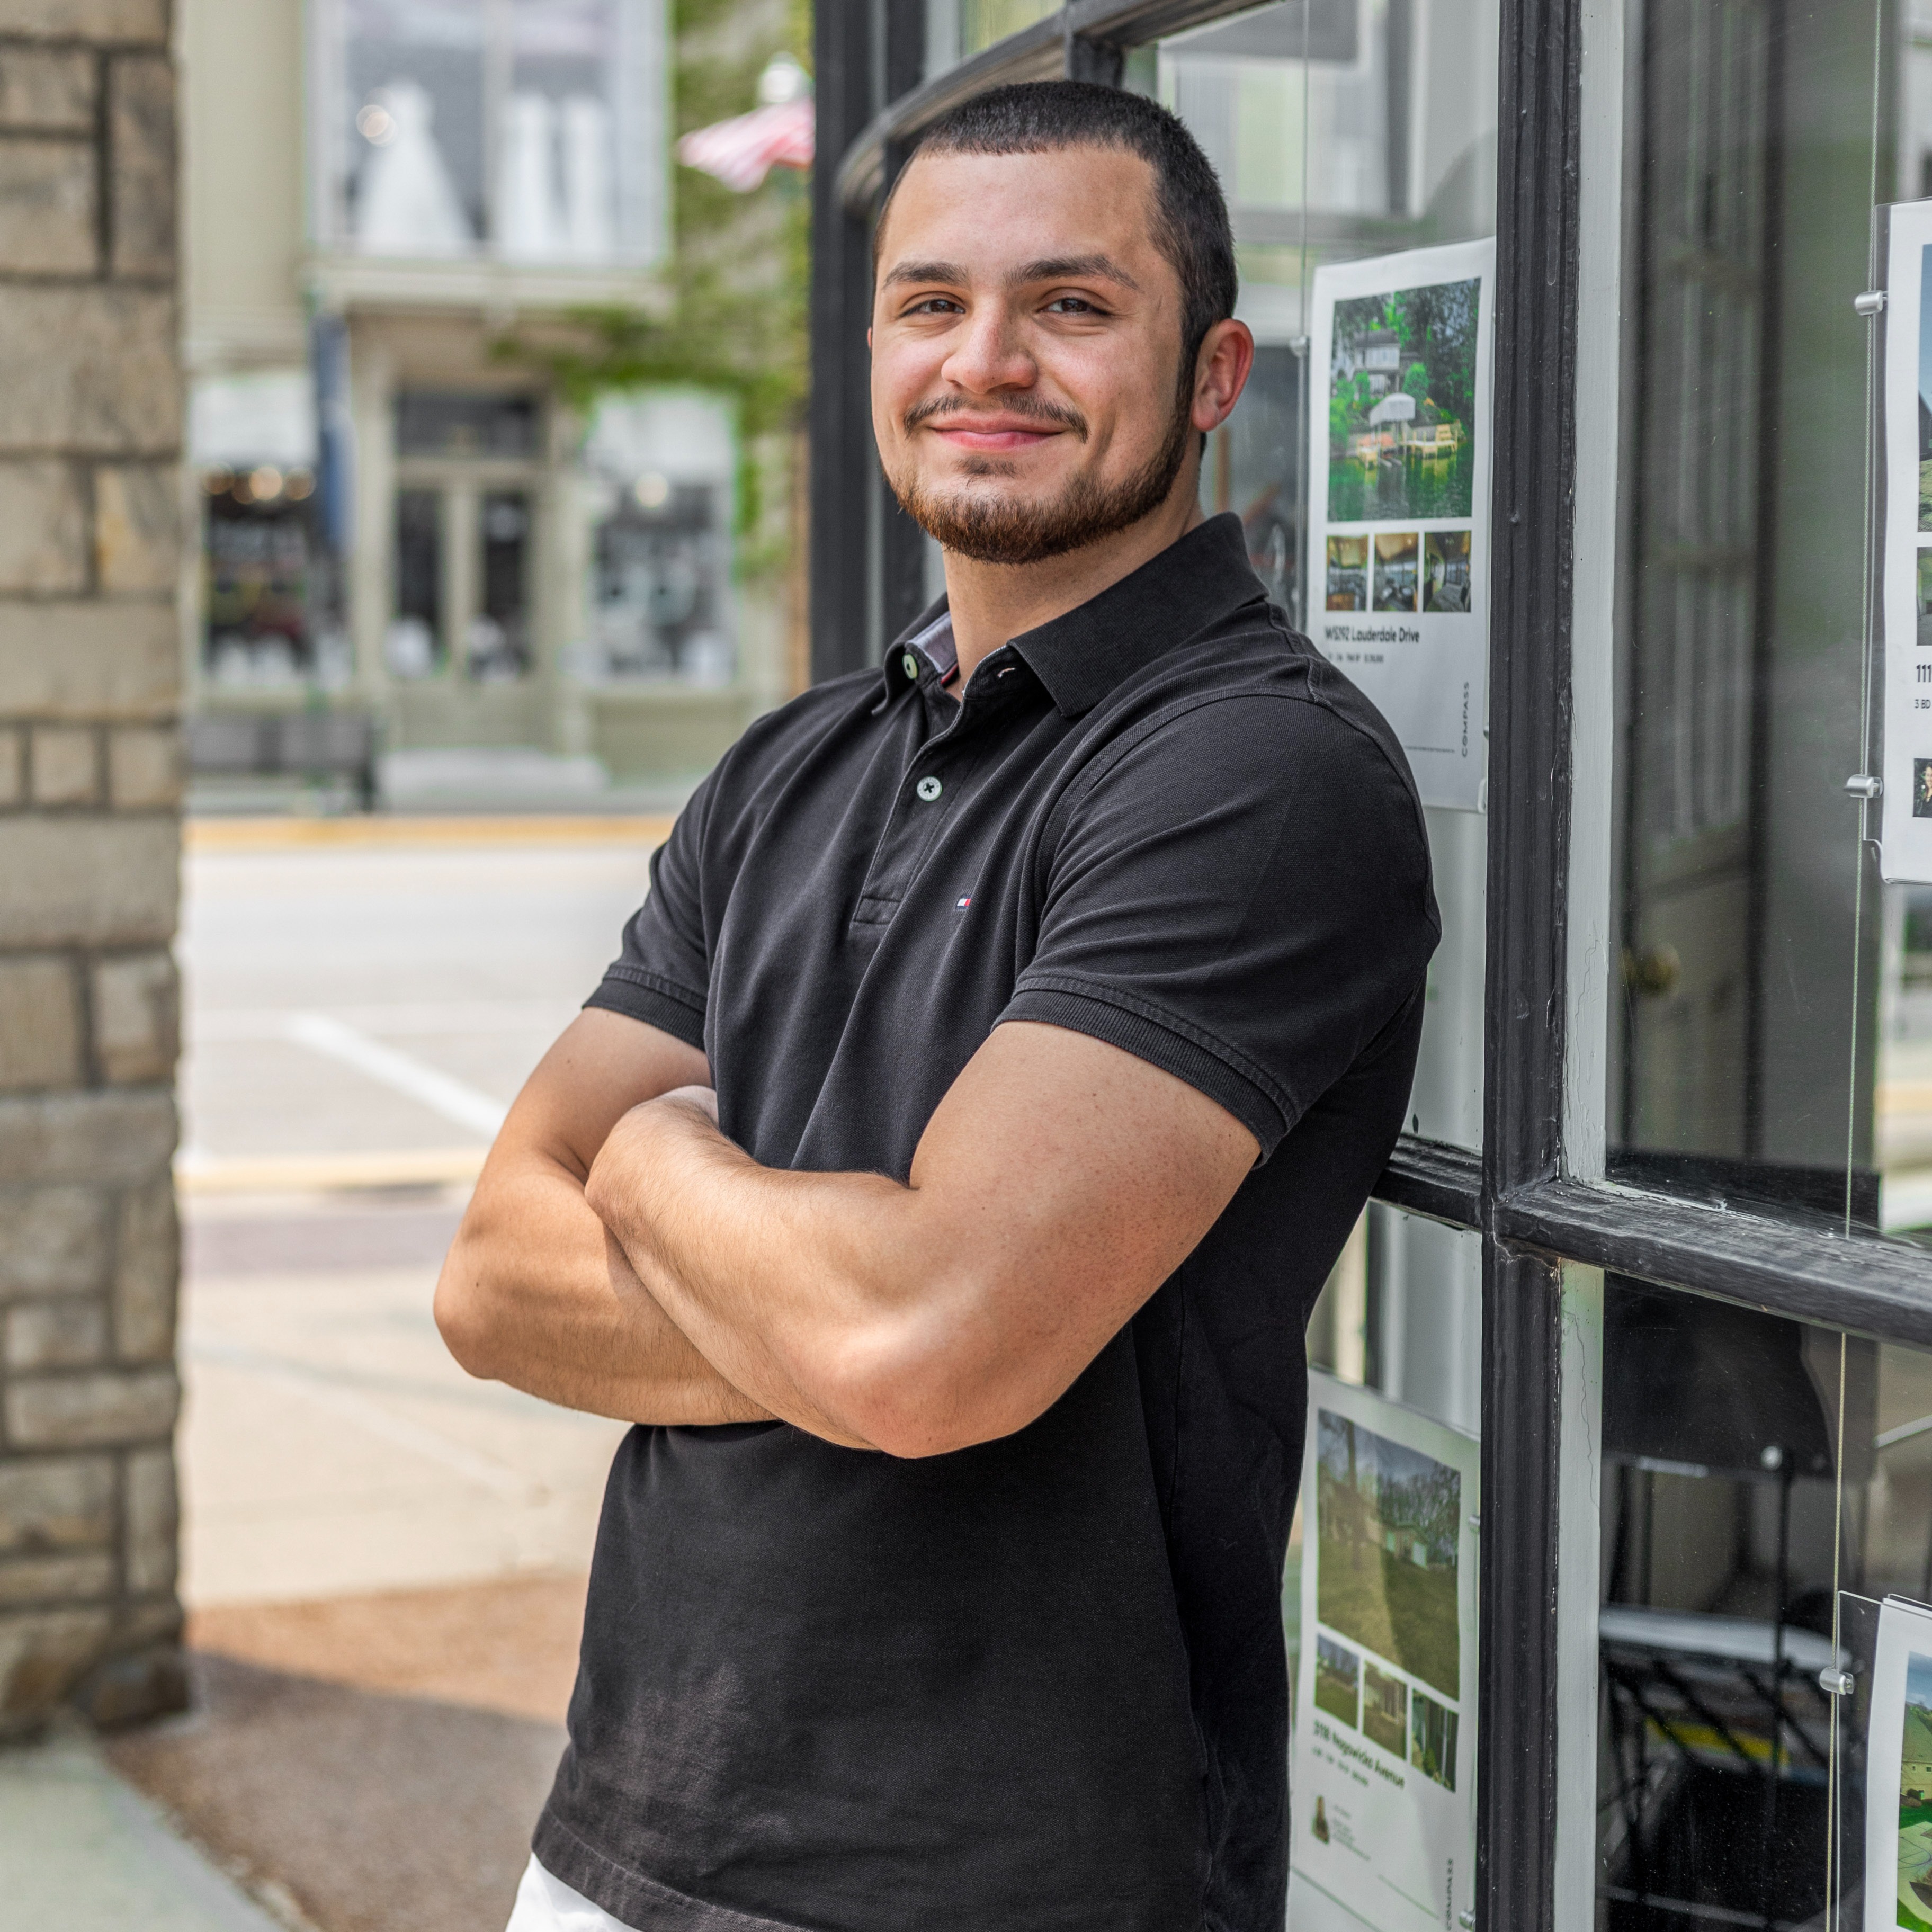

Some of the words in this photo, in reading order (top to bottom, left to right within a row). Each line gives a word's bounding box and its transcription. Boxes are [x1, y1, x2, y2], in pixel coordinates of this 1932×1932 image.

[1352, 625, 1397, 642] Lauderdale
[1399, 626, 1420, 642] Drive
[1915, 699, 1919, 709] 3
[1921, 699, 1931, 709] BD
